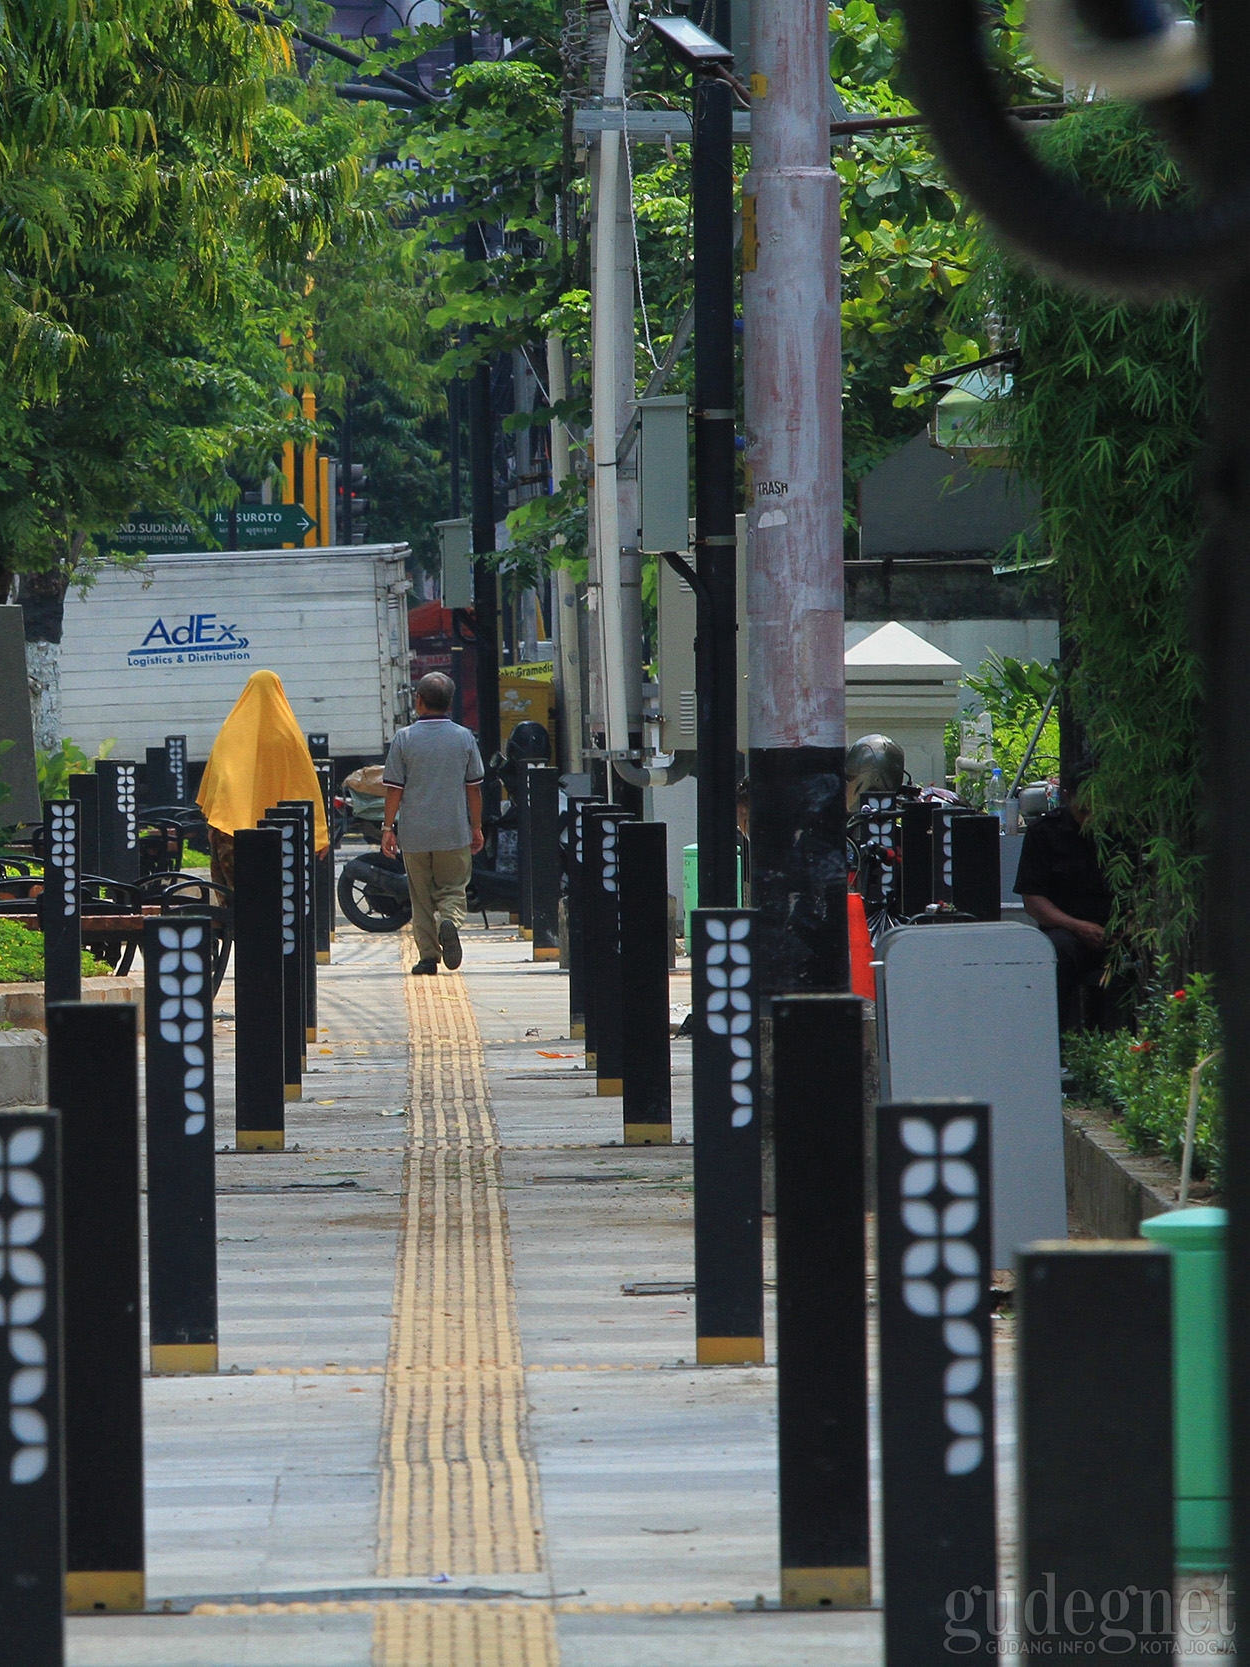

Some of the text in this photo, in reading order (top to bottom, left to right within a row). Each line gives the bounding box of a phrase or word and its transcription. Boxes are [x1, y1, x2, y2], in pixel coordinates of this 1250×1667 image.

[758, 481, 788, 496] TRASH
[214, 512, 282, 522] JL. SUROTO
[141, 614, 237, 646] AdEx
[127, 651, 250, 667] Logistics & Distribution
